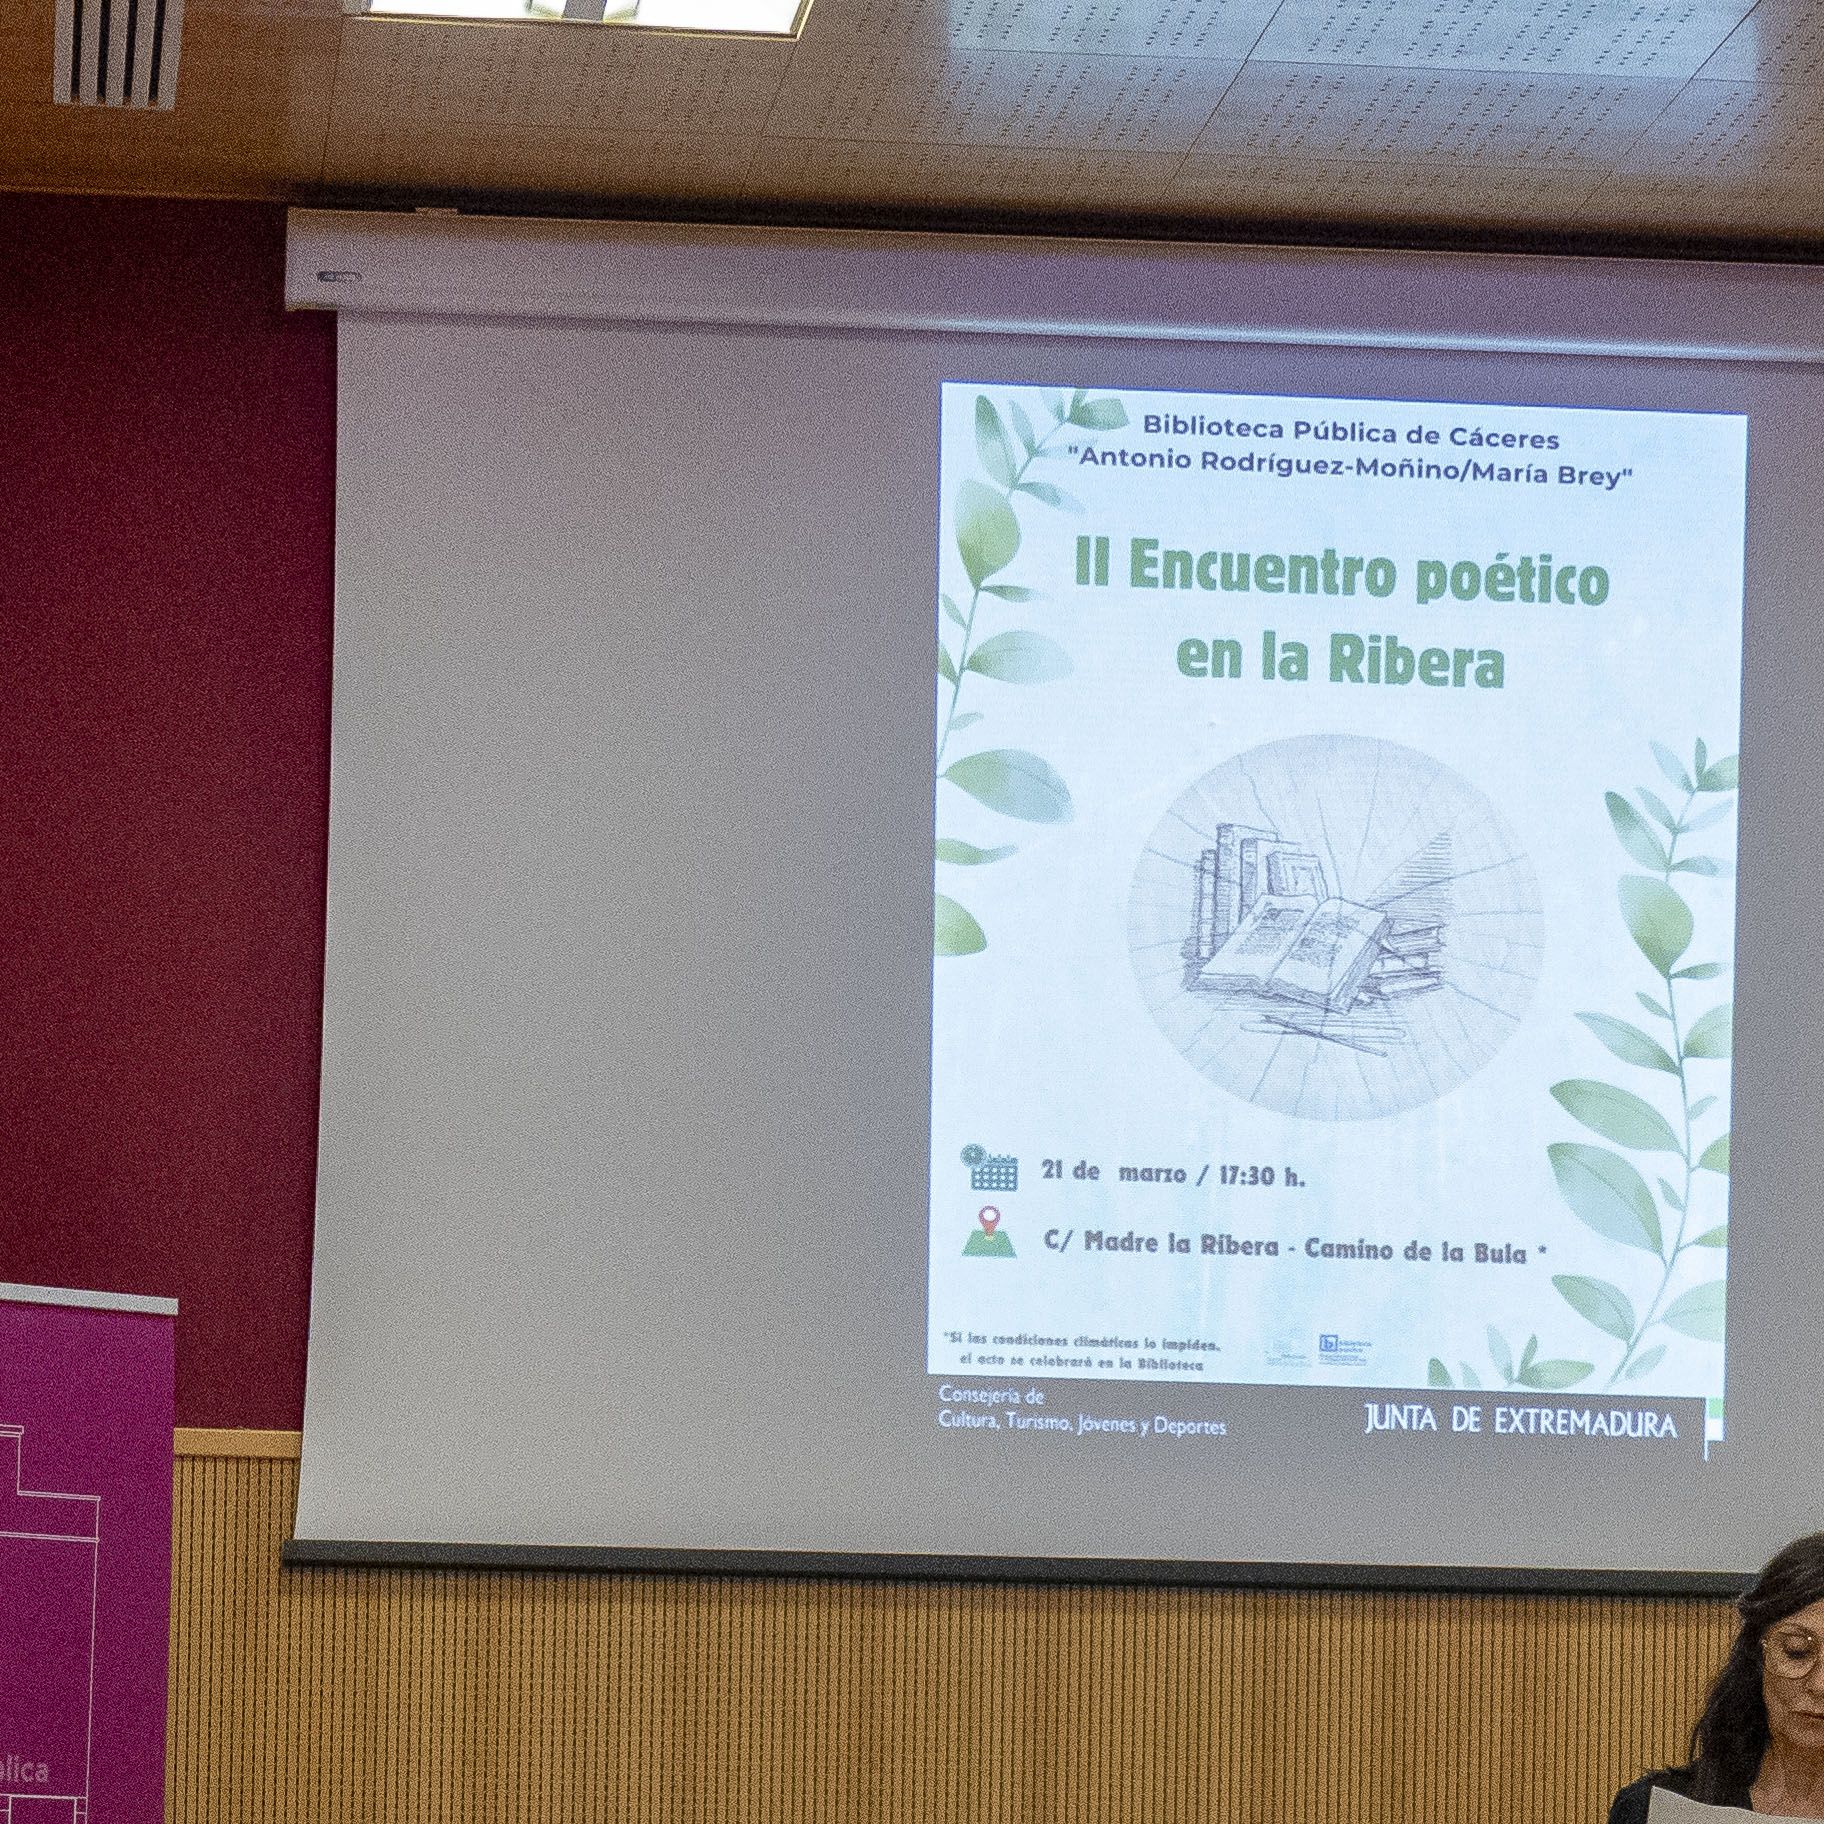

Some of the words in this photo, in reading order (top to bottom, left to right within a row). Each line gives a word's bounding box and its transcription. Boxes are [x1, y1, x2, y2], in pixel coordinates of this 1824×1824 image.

[1143, 414, 1284, 438] Biblioteca
[1294, 419, 1397, 443] Pública
[1406, 424, 1440, 445] de
[1449, 427, 1560, 449] Cáceres
[1068, 446, 1192, 468] "Antonio
[1201, 451, 1548, 483] Rodríguez-Moñino/María
[1558, 465, 1633, 490] Brey"
[1074, 535, 1111, 587] II
[1130, 541, 1397, 598] Encuentro
[1416, 551, 1612, 607] poético
[1176, 636, 1243, 680] en
[1262, 631, 1310, 682] la
[1329, 633, 1506, 690] Ribera
[1042, 1158, 1063, 1179] 21
[1072, 1160, 1100, 1180] de
[1119, 1166, 1187, 1183] marzo
[1220, 1165, 1275, 1187] 17:30
[1284, 1167, 1306, 1187] h.
[1043, 1228, 1074, 1253] C/
[1084, 1230, 1159, 1253] Madre
[1168, 1232, 1191, 1254] la
[1200, 1233, 1279, 1256] Ribera
[1304, 1237, 1394, 1260] Camino
[1403, 1240, 1432, 1262] de
[1441, 1241, 1464, 1262] la
[1475, 1242, 1527, 1264] Bula
[992, 1334, 1069, 1347] condiciones
[1137, 1358, 1204, 1371] Biblioteca
[938, 1383, 1020, 1407] Consejería
[1025, 1387, 1045, 1405] de
[938, 1409, 1001, 1430] Cultura,
[1005, 1410, 1074, 1432] Turismo,
[1077, 1413, 1137, 1436] Jóvenes
[1140, 1419, 1150, 1437] y
[1154, 1416, 1227, 1438] Deportes
[1363, 1402, 1438, 1435] JUNTA
[1451, 1406, 1482, 1434] DE
[1494, 1406, 1678, 1439] EXTREMADURA
